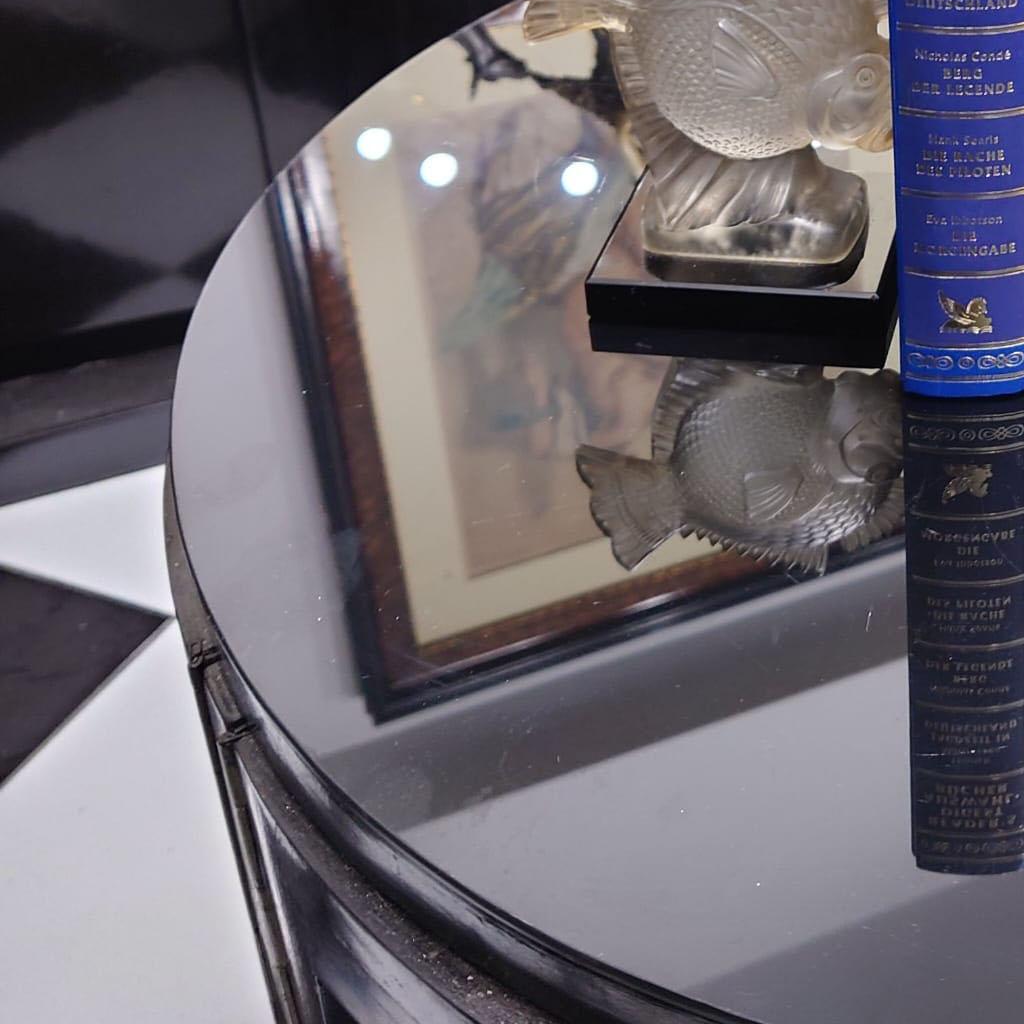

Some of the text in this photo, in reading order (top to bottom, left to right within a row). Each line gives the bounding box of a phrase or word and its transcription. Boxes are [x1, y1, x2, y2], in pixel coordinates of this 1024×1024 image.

[914, 48, 968, 62] Nicholas
[943, 67, 983, 80] BERG
[911, 81, 1015, 95] DER LEGENDE
[922, 149, 1005, 163] DIE RACHE
[915, 163, 1012, 178] DES PILOTEN
